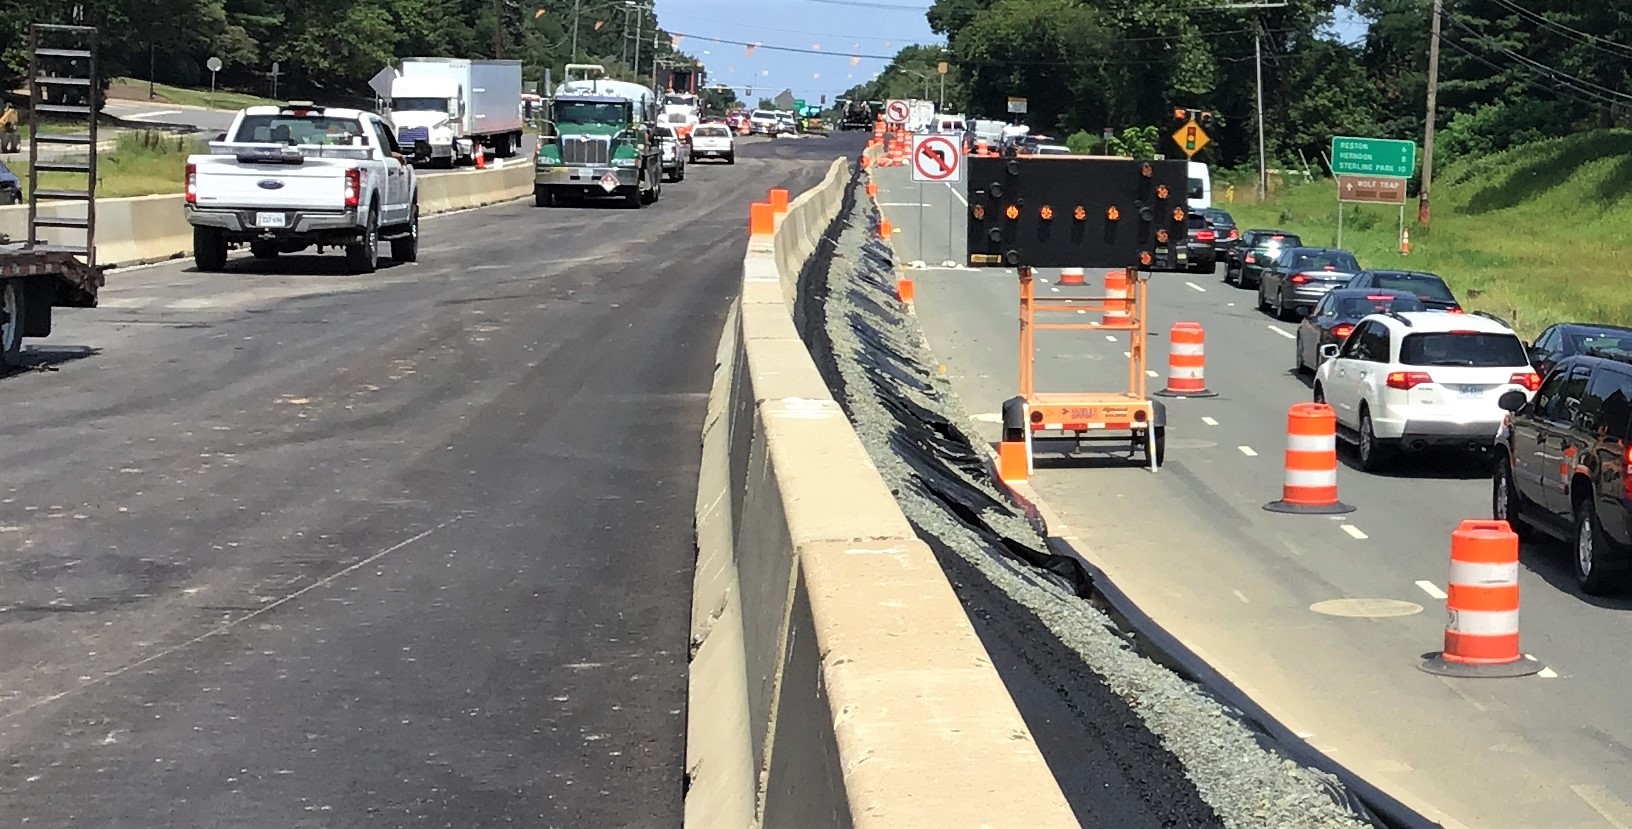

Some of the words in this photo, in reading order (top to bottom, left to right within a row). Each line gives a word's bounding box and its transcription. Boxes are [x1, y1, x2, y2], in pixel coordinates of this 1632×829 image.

[1340, 142, 1368, 150] RESTON
[1339, 152, 1373, 161] HERNDON
[1339, 162, 1373, 171] STERLING
[1375, 164, 1394, 172] PARK
[1357, 180, 1377, 188] WOLF
[1380, 181, 1400, 189] TRAP
